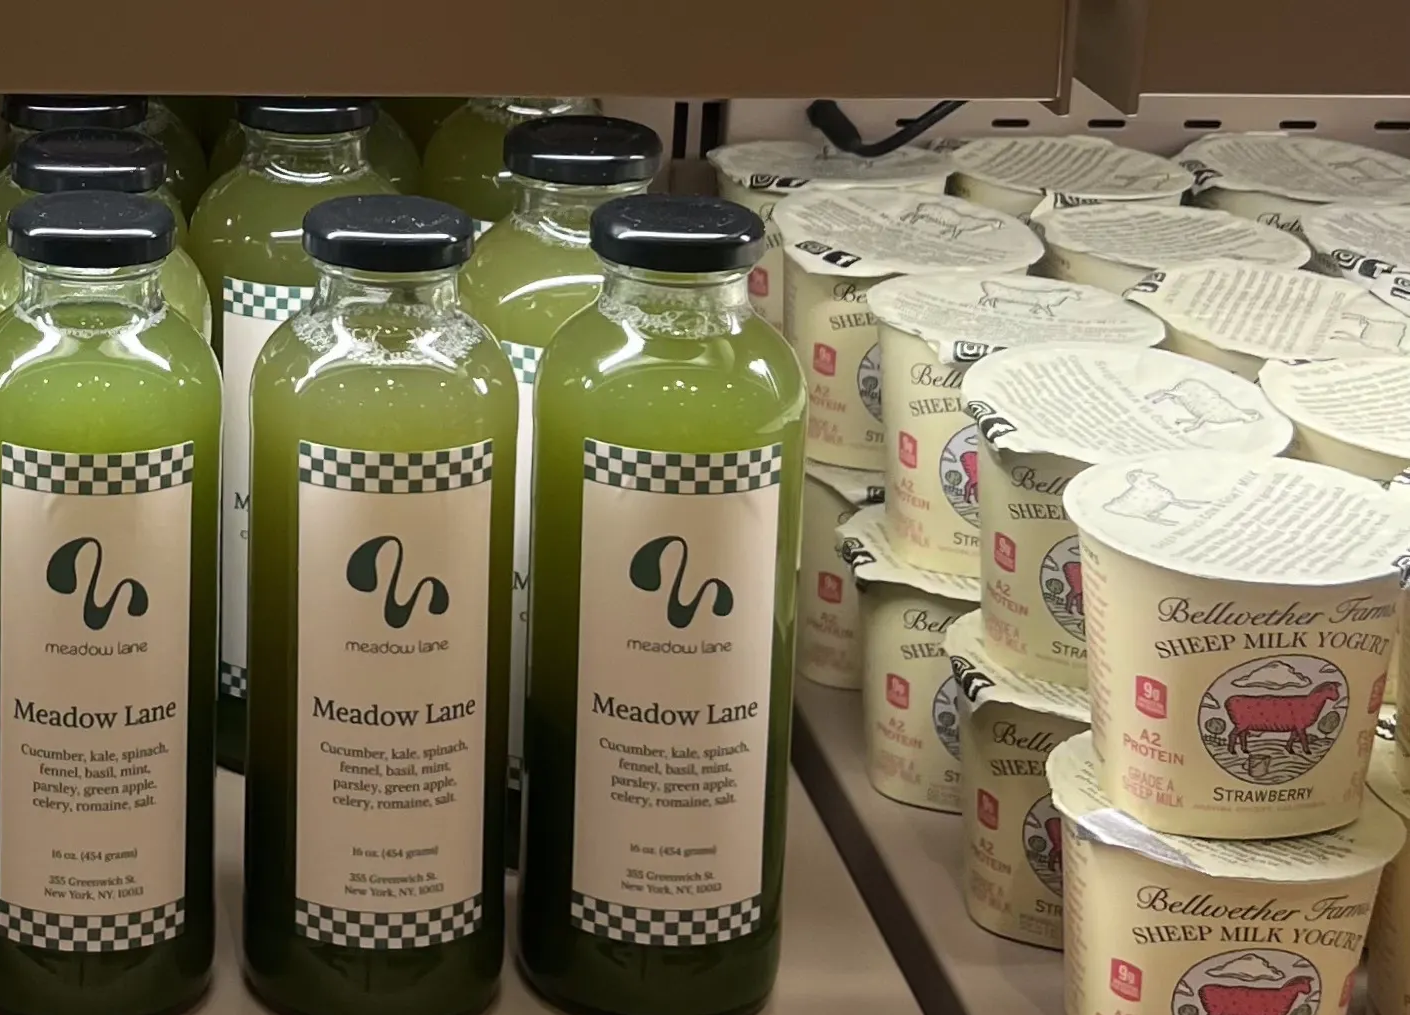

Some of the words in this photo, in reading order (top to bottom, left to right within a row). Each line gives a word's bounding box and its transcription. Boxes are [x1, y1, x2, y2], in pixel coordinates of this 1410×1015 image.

[1158, 597, 1326, 626] Bellwether
[45, 642, 113, 656] meadow
[118, 641, 148, 655] lane
[345, 640, 415, 654] meadow
[418, 640, 449, 653] lane
[627, 638, 697, 653] meadow
[702, 640, 732, 654] lane
[1155, 634, 1236, 659] SHEEP
[1244, 632, 1307, 649] MILK
[14, 698, 118, 729] Meadow
[125, 701, 176, 726] Lane
[312, 696, 419, 726] Meadow
[426, 699, 475, 724] Lane
[592, 692, 700, 725] Meadow
[707, 701, 758, 724] Lane
[1140, 729, 1162, 747] A2
[21, 743, 86, 762] Cucumber,
[90, 750, 118, 762] kale,
[321, 741, 388, 761] Cucumber,
[391, 748, 420, 760] kale,
[423, 740, 468, 760] spinach,
[1123, 733, 1184, 766] PROTEIN
[40, 763, 81, 779] fennel,
[85, 766, 116, 779] basil,
[340, 761, 382, 777] fennel,
[386, 765, 417, 776] basil,
[33, 781, 80, 796] parsley,
[84, 785, 118, 797] green
[333, 779, 381, 794] parsley,
[384, 782, 420, 794] green
[33, 797, 72, 813] celery,
[76, 800, 131, 812] romaine,
[333, 795, 373, 811] celery,
[377, 798, 432, 810] romaine,
[1137, 886, 1300, 921] Bellwether
[1132, 926, 1212, 944] SHEEP
[1220, 926, 1283, 944] MILK
